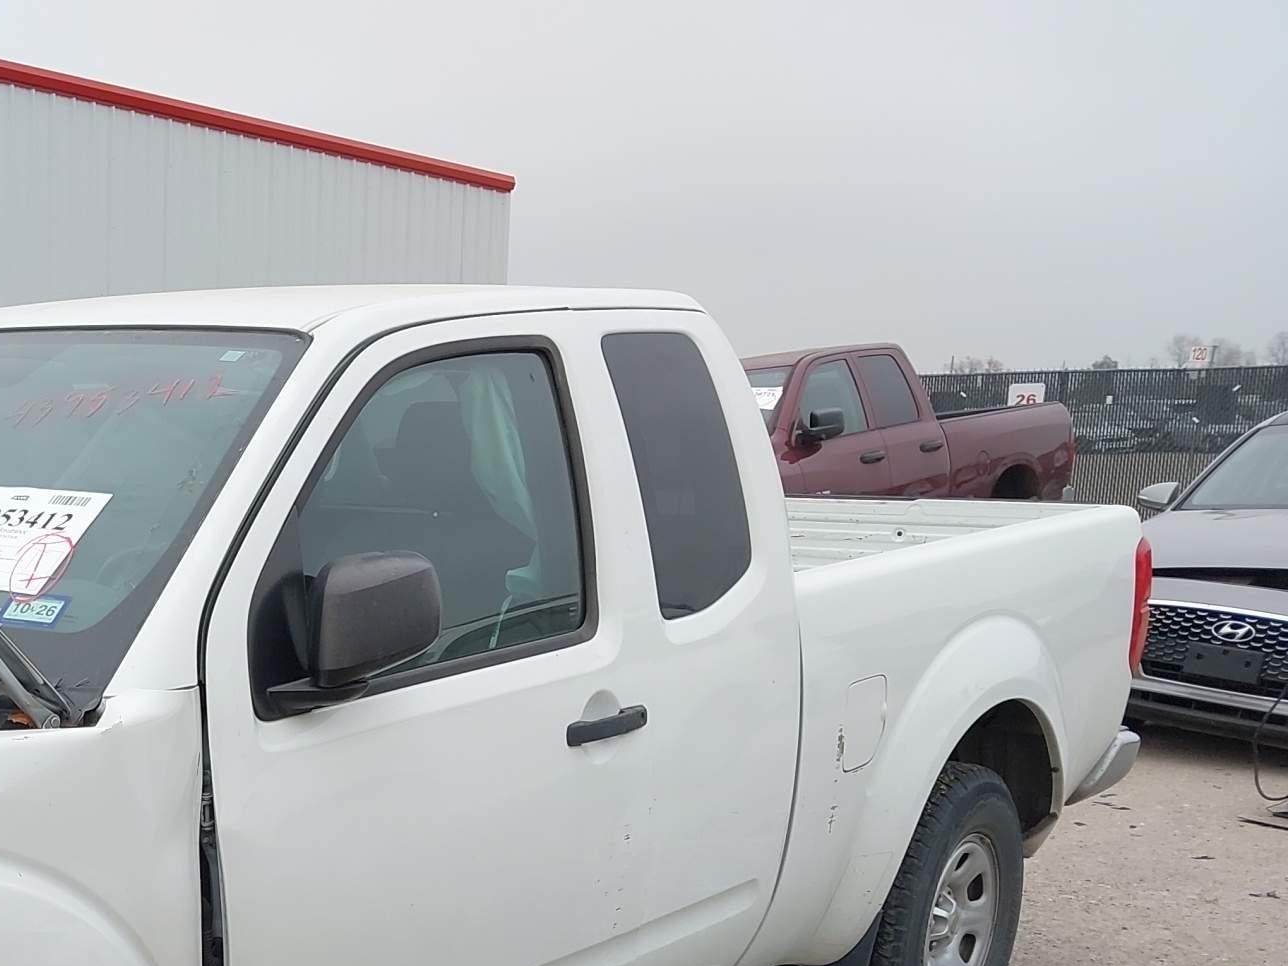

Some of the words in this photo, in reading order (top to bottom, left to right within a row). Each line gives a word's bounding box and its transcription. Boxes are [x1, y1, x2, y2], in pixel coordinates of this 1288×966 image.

[1192, 347, 1208, 361] 120
[1015, 393, 1037, 406] 26
[35, 605, 58, 617] 26
